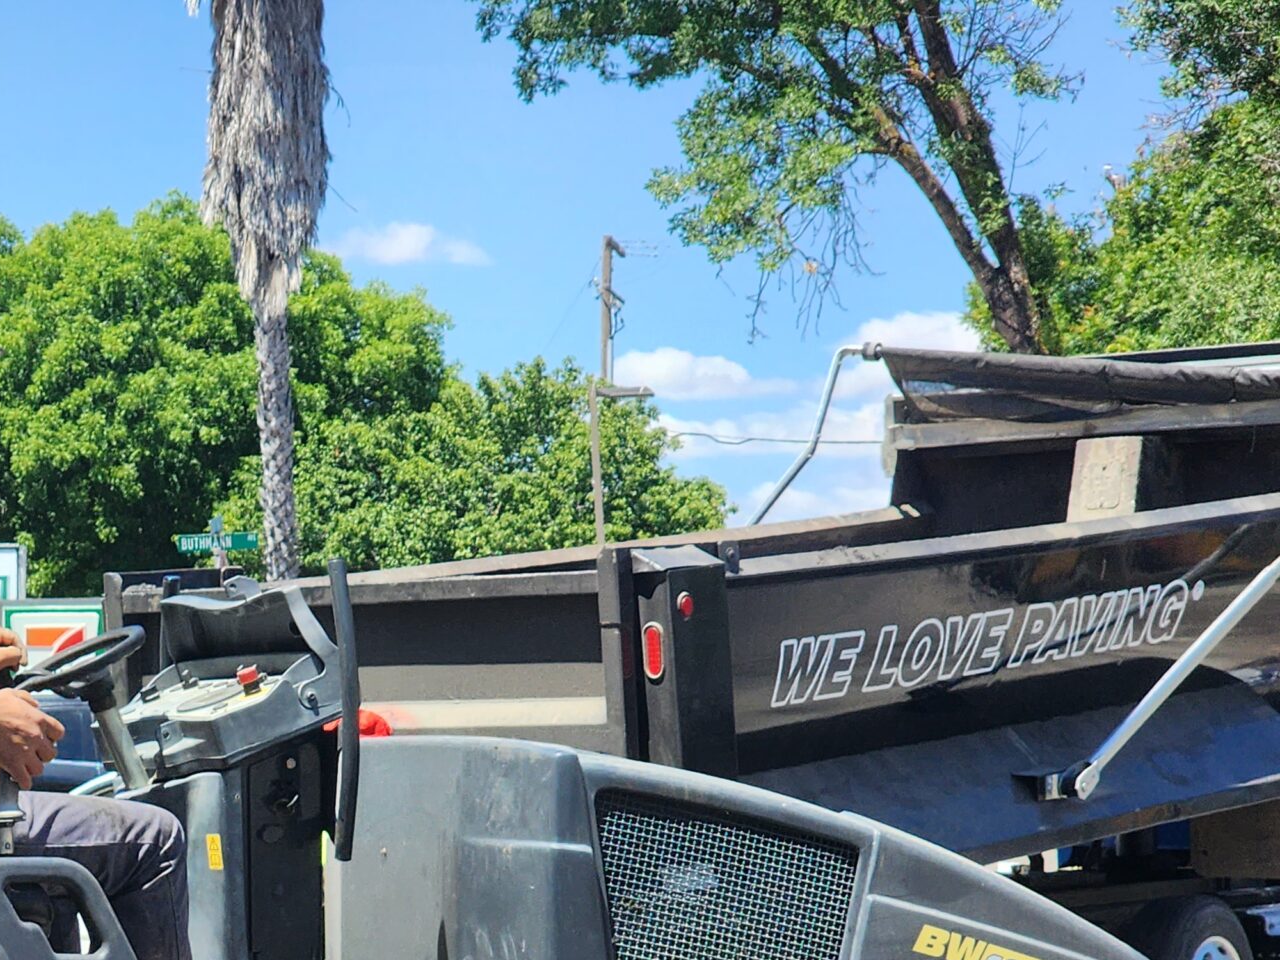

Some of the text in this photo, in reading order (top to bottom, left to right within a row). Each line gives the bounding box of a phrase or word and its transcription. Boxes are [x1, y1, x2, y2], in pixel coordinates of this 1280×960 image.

[771, 579, 1188, 708] WE LOVE PAVING
